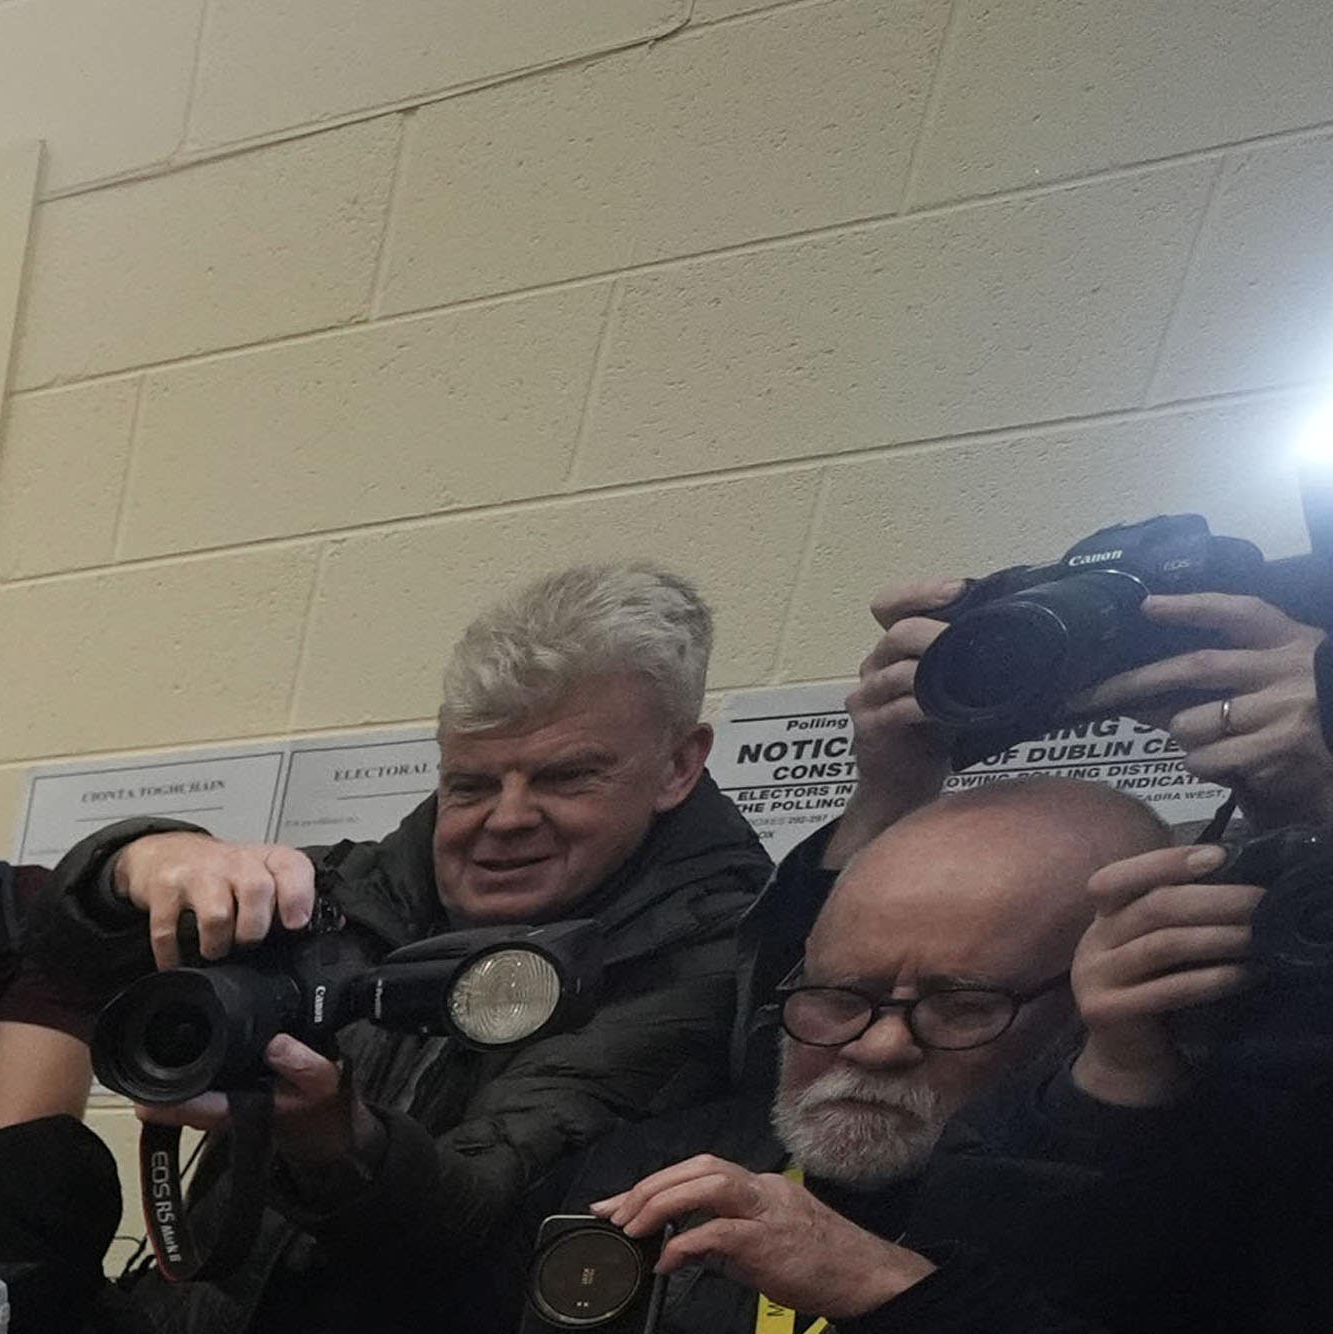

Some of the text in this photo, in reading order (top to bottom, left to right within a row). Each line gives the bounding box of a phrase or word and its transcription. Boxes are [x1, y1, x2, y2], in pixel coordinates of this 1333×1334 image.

[1068, 550, 1123, 567] Canon
[786, 718, 849, 731] Polling
[1026, 740, 1134, 763] DUBLIN
[333, 763, 429, 782] ELECTORAL
[738, 785, 829, 801] ELECTORS
[835, 784, 853, 795] IN
[770, 797, 846, 811] POLLING
[1116, 774, 1200, 790] INDICAT
[151, 1151, 172, 1199] EOS
[154, 1200, 176, 1223] R5
